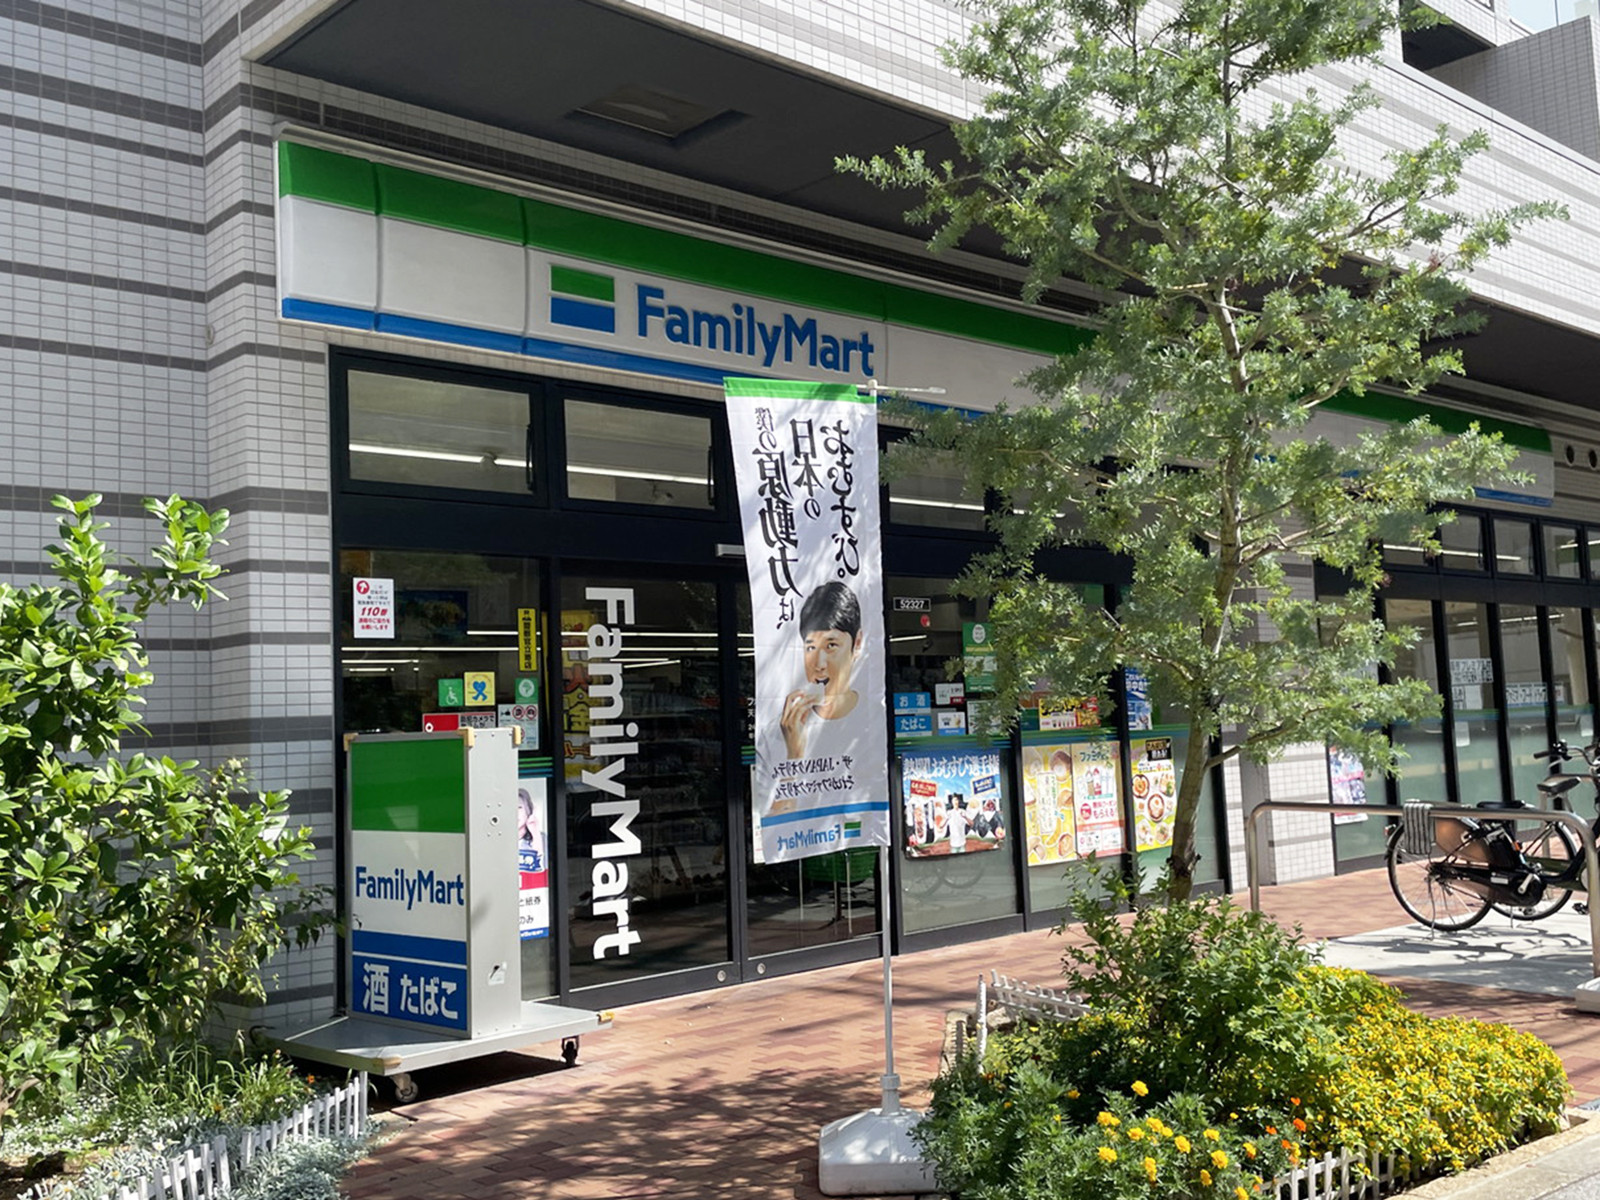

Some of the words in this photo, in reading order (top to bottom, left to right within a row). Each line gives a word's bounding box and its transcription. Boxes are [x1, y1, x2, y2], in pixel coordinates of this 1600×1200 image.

[636, 284, 875, 377] FamilyMart
[899, 599, 925, 610] 52327
[900, 718, 927, 731] たばこ
[581, 587, 643, 960] FamilyMart
[355, 866, 465, 910] FamilyMart
[361, 962, 390, 1015] 酒
[399, 974, 459, 1020] たばこ
